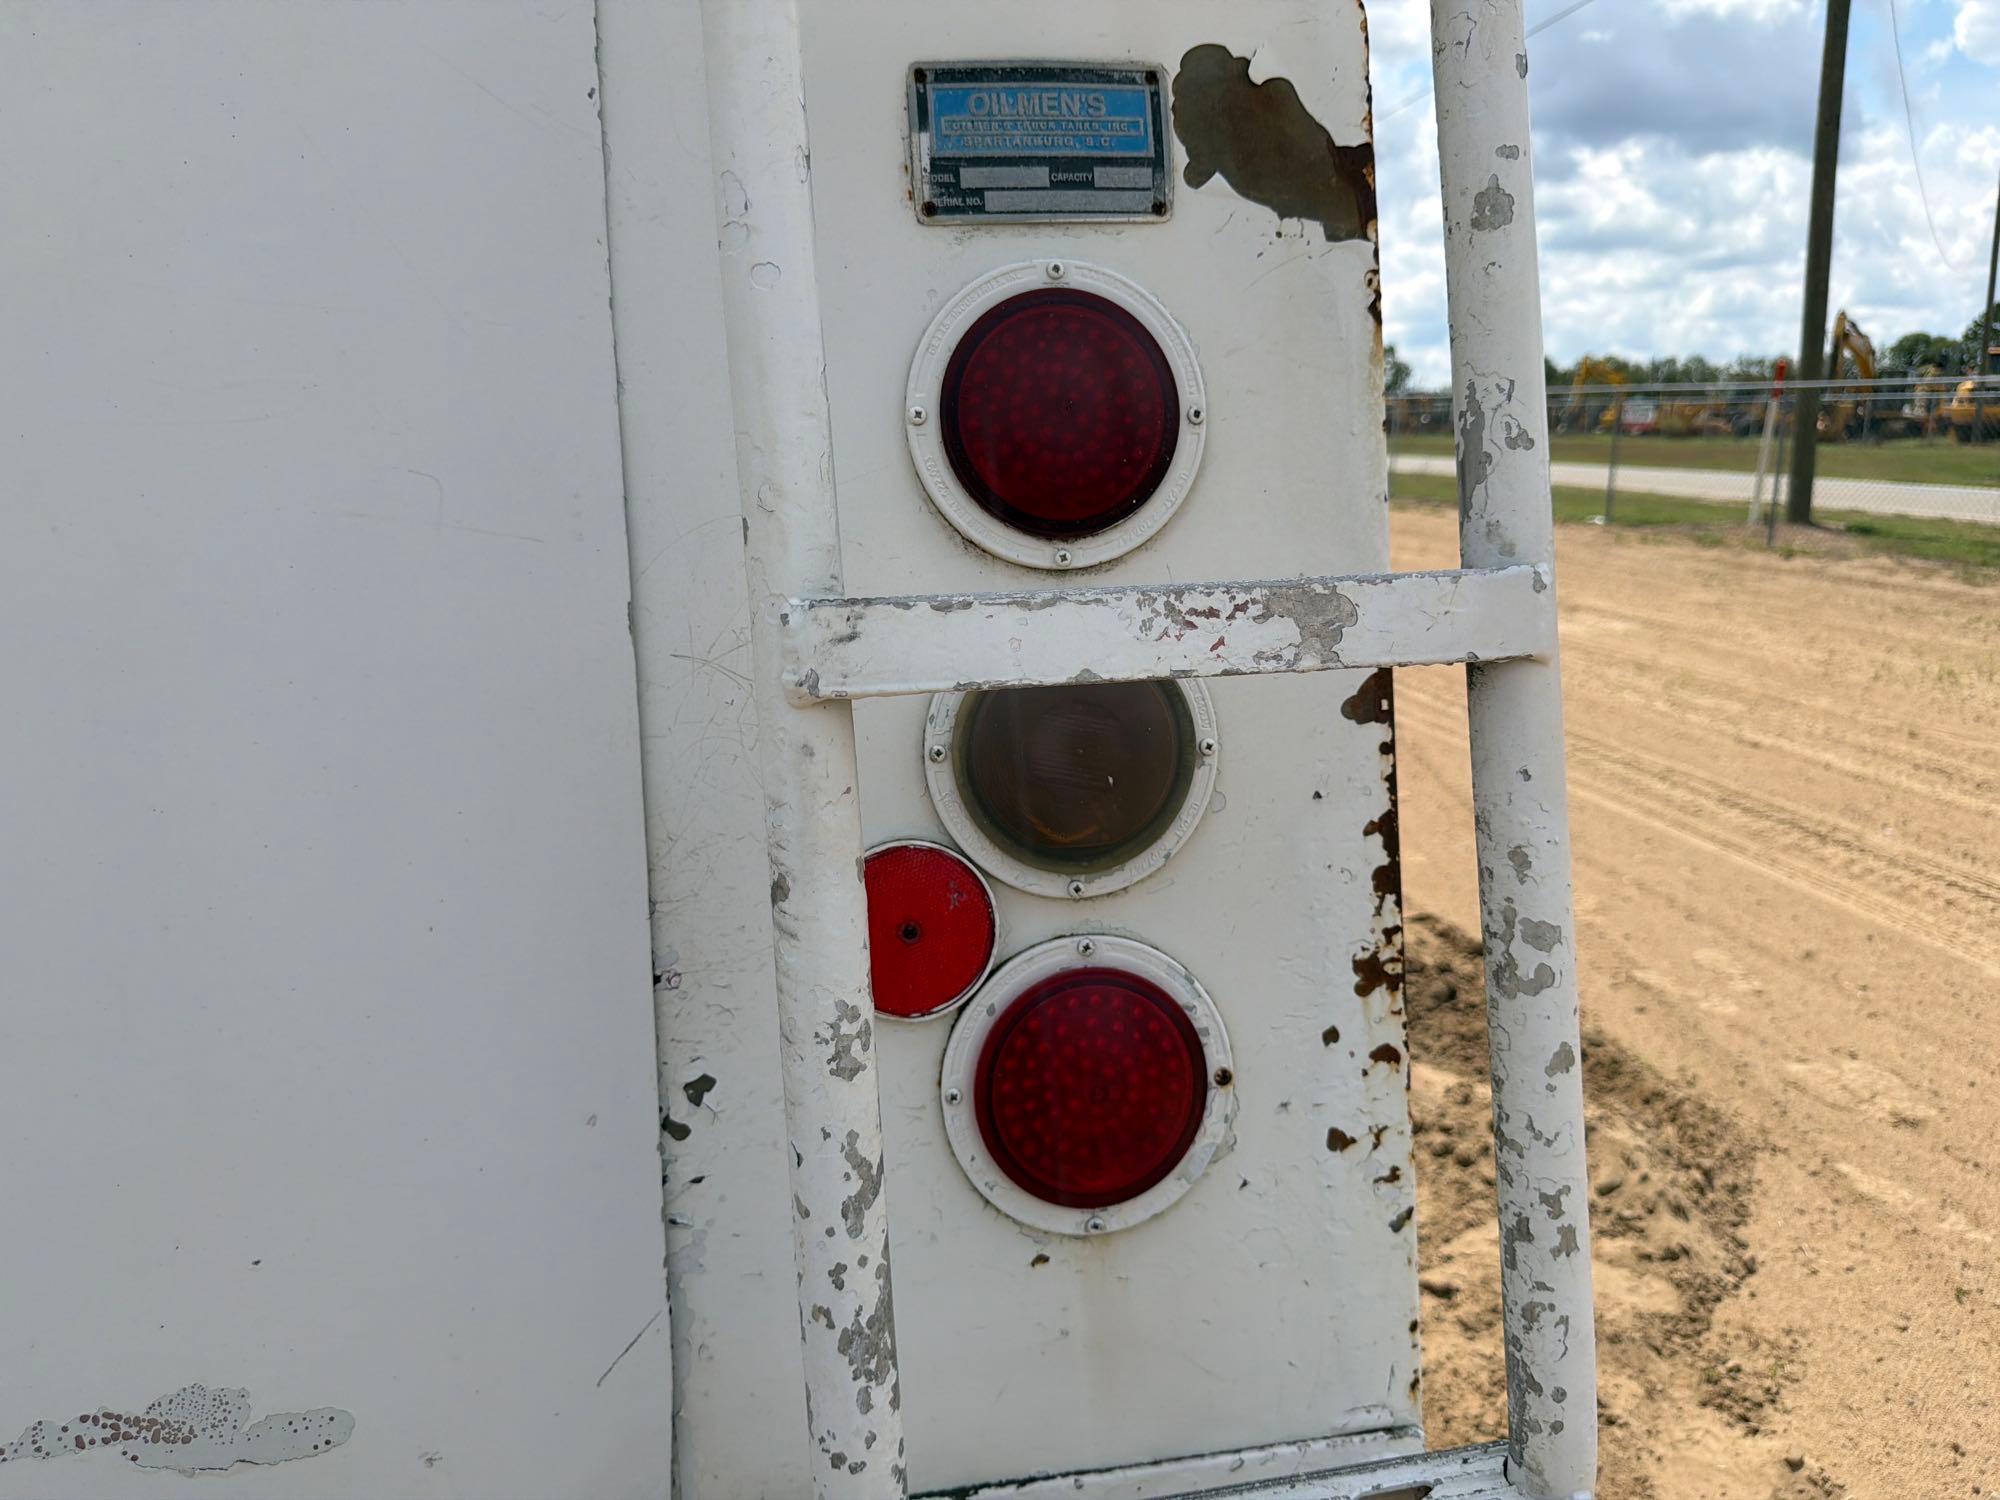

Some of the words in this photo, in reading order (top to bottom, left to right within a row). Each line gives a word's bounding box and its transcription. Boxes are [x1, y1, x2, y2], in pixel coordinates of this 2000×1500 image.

[968, 92, 1106, 117] OILMEN'S
[1016, 120, 1056, 131] TRUCK
[1051, 173, 1094, 183] CAPACITY
